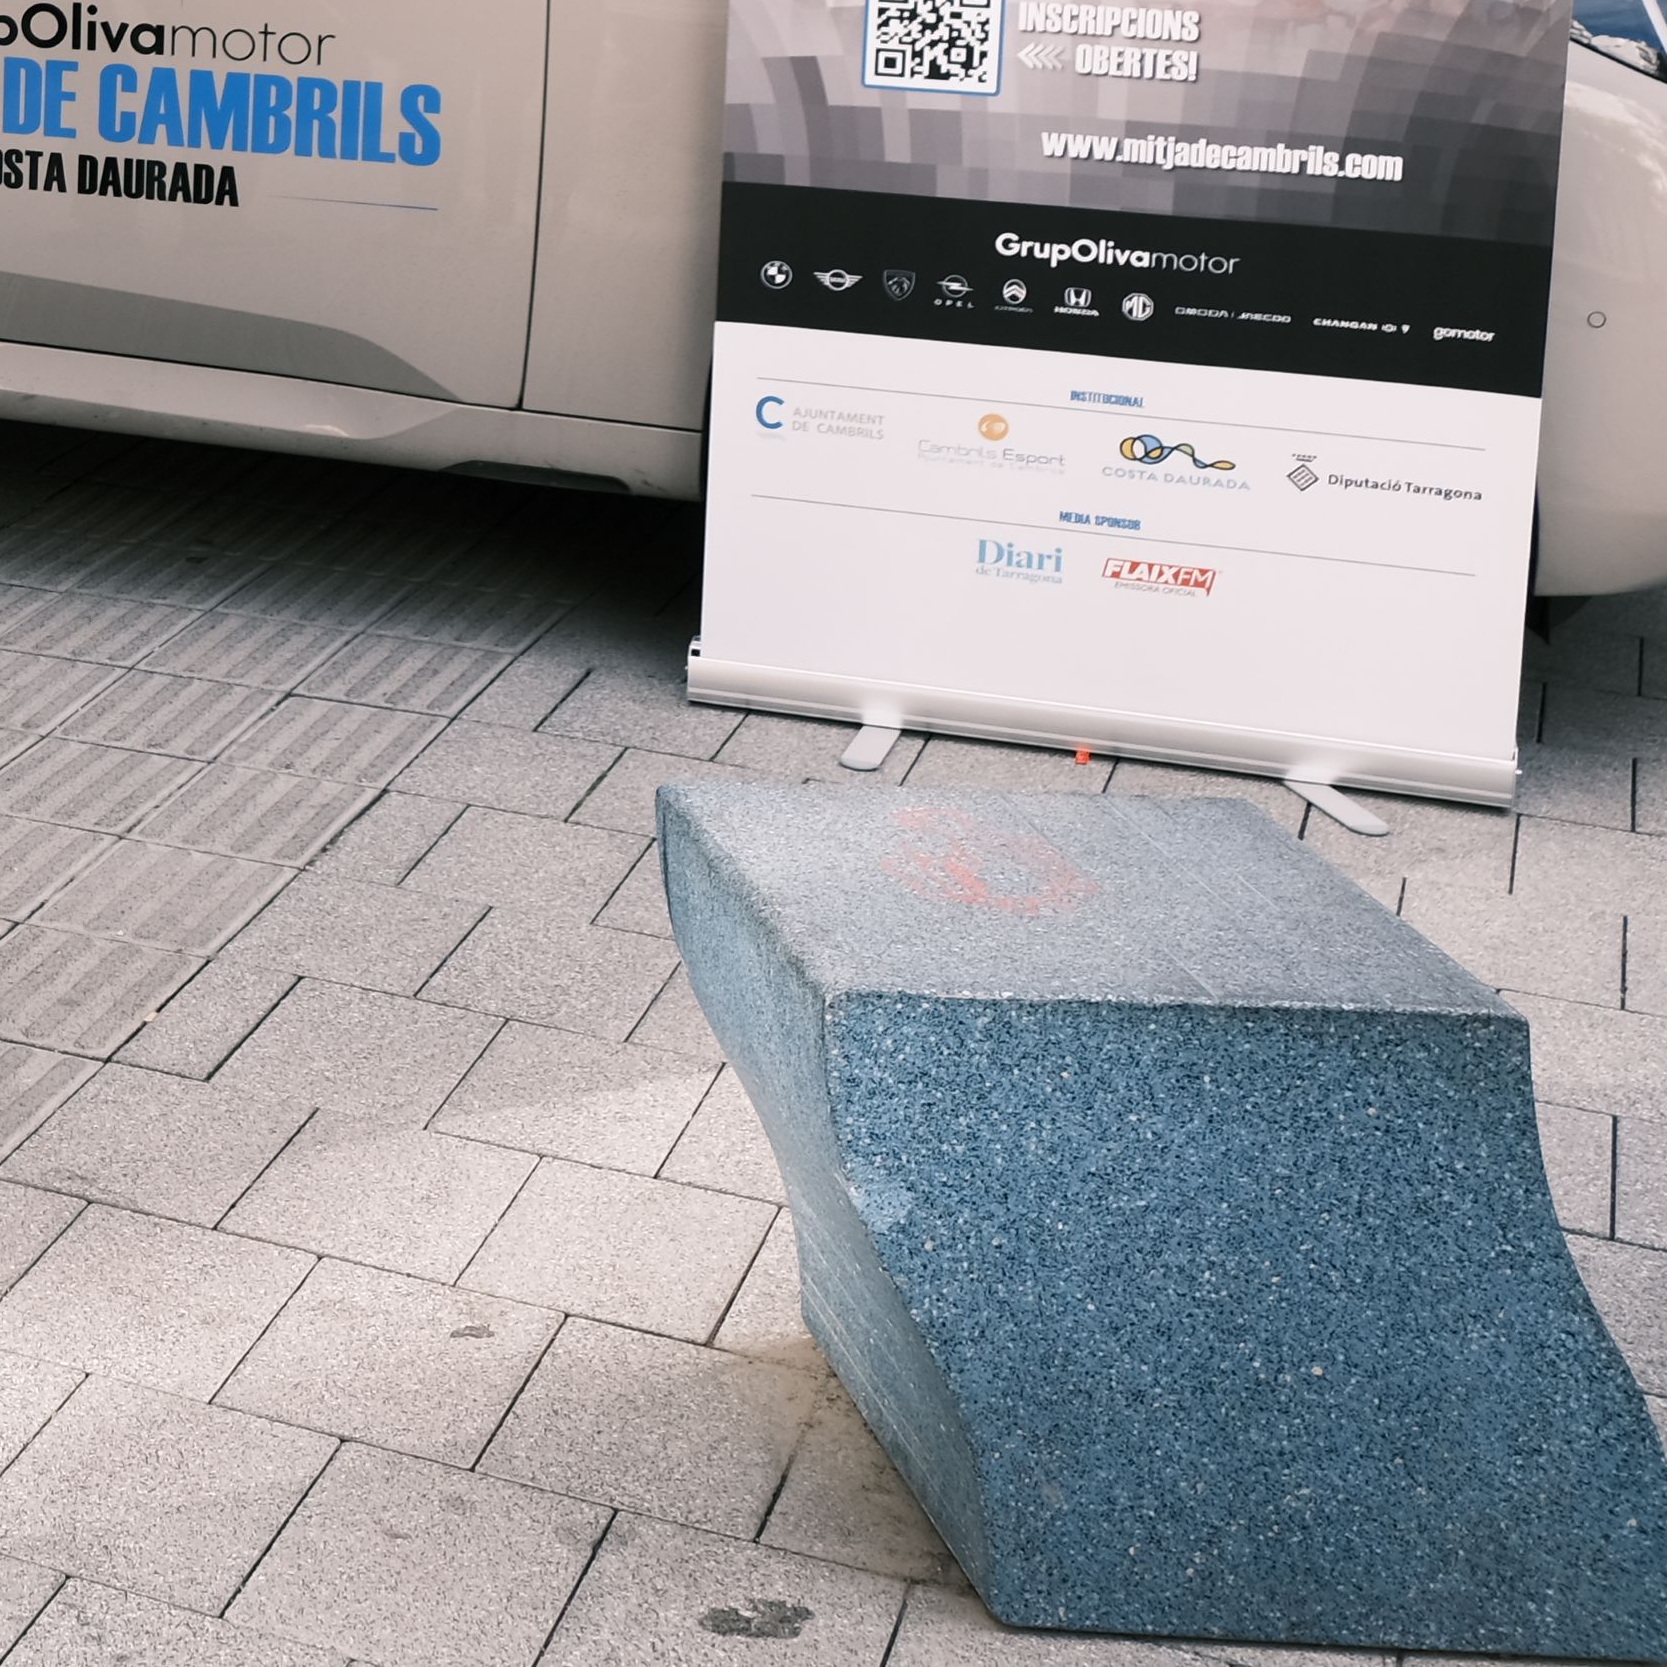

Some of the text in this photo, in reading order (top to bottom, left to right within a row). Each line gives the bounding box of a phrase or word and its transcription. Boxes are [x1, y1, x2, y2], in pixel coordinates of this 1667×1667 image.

[1017, 0, 1201, 43] INSCRIPCIONS
[1074, 43, 1198, 82] OBERTES!
[3, 57, 76, 139] DE
[98, 63, 442, 167] CAMBRILS
[1041, 130, 1405, 182] www.mitjadecambrils.com
[78, 155, 240, 208] DAURADA
[995, 232, 1242, 275] GrupOlivamotor
[933, 297, 975, 309] OPEL
[1433, 326, 1496, 342] gomotor
[791, 419, 885, 441] DE CAMBRILS
[792, 406, 885, 426] AJUNTAMENT
[917, 438, 1066, 468] Cambrils Esport
[1101, 465, 1252, 492] COSTA DAURADA
[1327, 473, 1483, 502] Diputació Tarragona
[976, 538, 1064, 573] Diari
